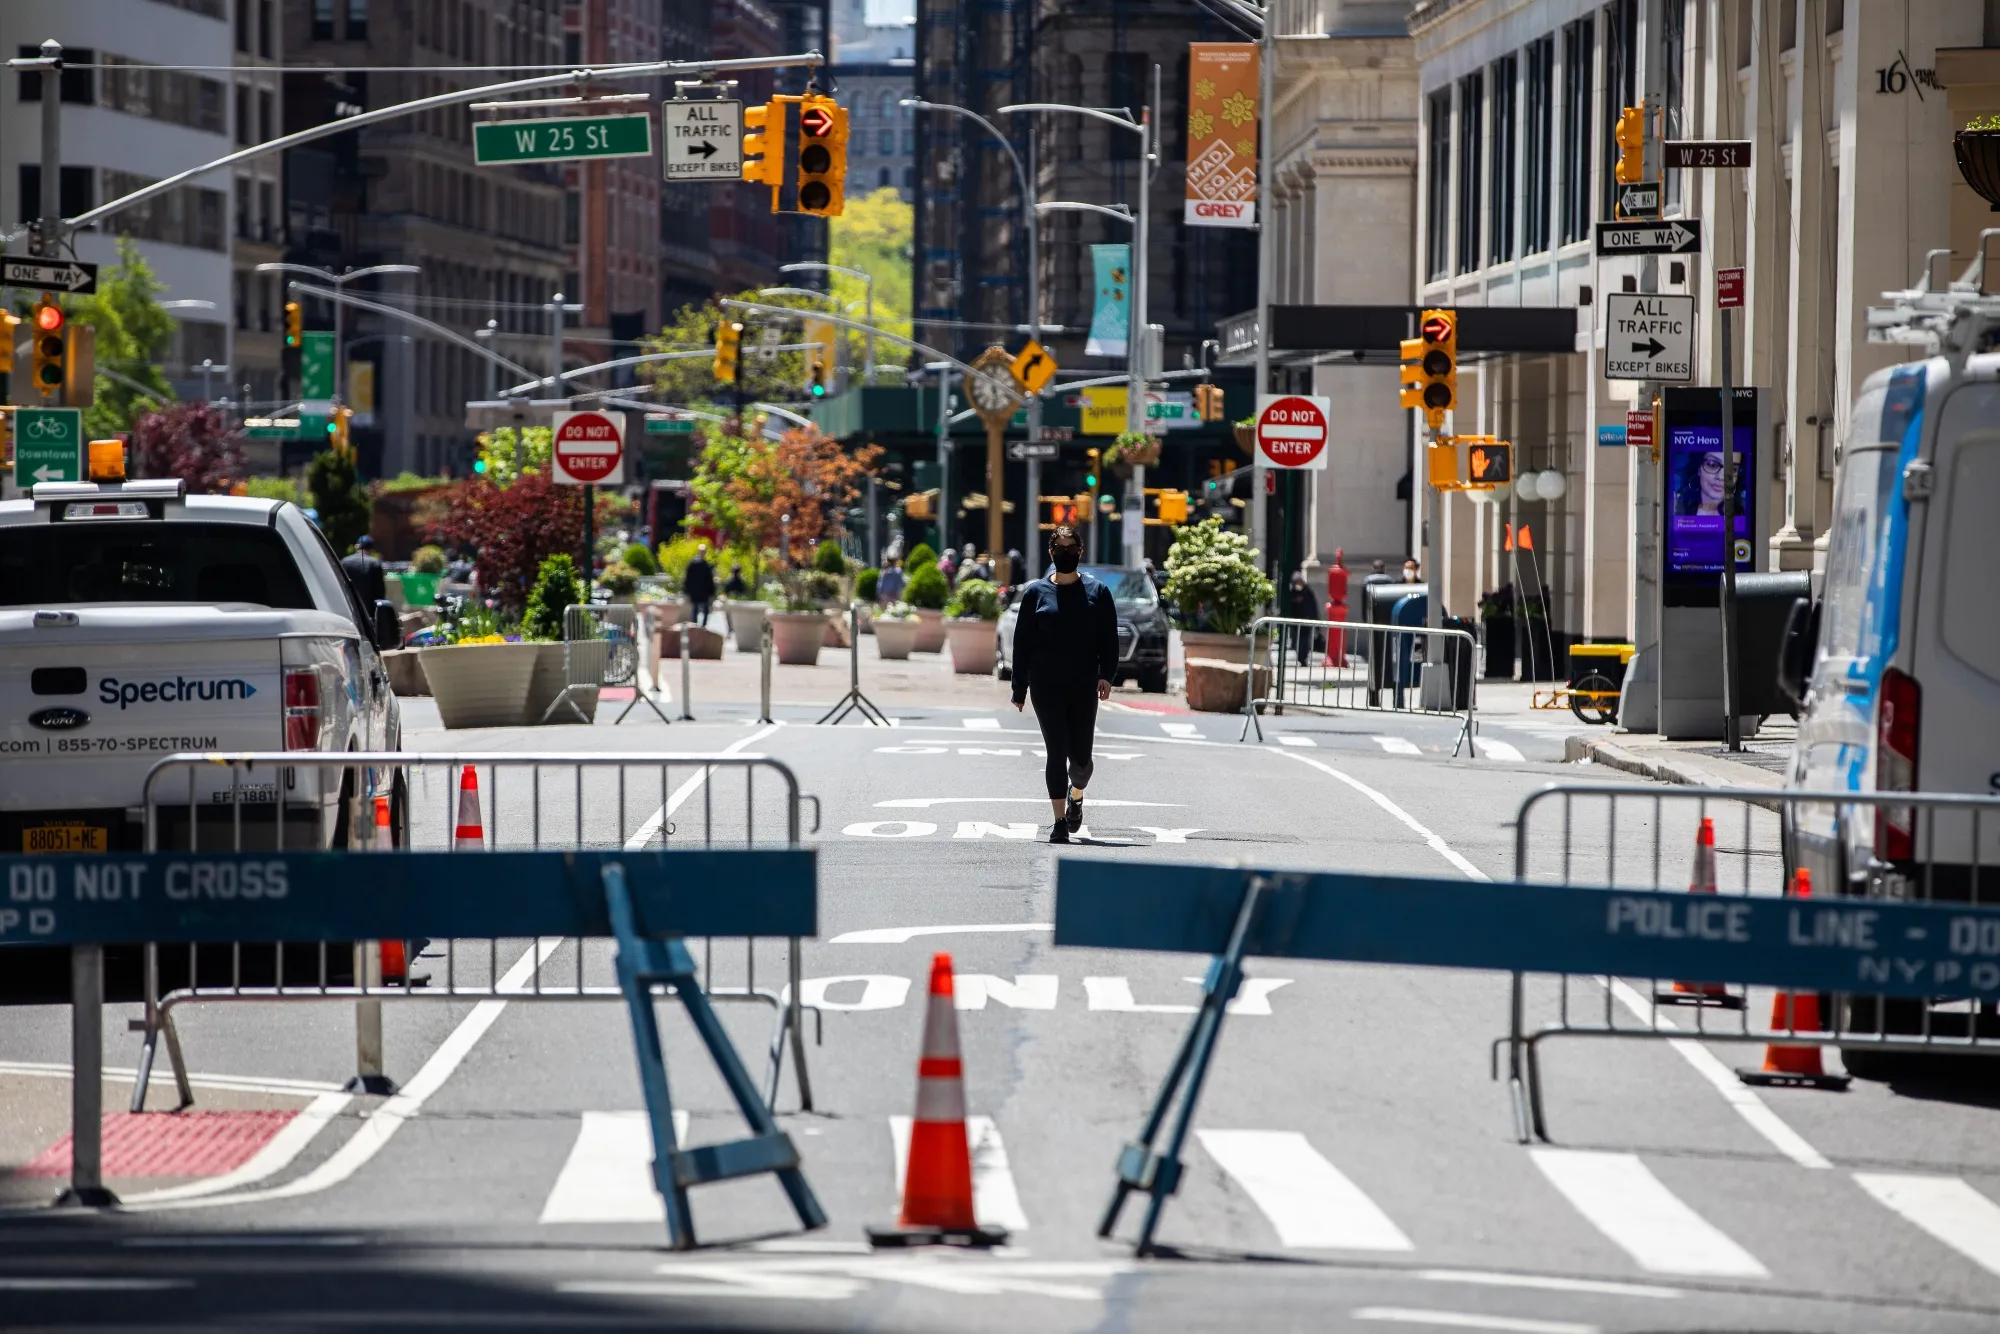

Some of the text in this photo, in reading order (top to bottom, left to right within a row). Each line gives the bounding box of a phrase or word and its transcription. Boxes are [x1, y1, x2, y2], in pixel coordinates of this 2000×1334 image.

[1876, 59, 1907, 94] 16
[687, 106, 718, 121] ALL
[515, 125, 609, 152] W 25 St
[674, 124, 732, 138] TRAFFIC
[1680, 149, 1737, 165] W 25 St
[669, 161, 739, 173] EXCEPT BIKES
[1188, 149, 1230, 184] MAD.
[1202, 173, 1232, 197] SQ.
[1624, 192, 1655, 207] ONE WAY
[1195, 203, 1245, 219] GREY
[1611, 229, 1685, 246] ONE WAY
[12, 265, 82, 283] ONE WAY
[1633, 299, 1668, 316] ALL
[1617, 319, 1683, 334] TRAFFIC
[1609, 361, 1688, 374] EXCEPT BIKES
[1270, 409, 1316, 422] DO NOT
[566, 426, 610, 437] DO NOT
[1271, 441, 1312, 454] ENTER
[1674, 436, 1719, 445] NYC Hero
[19, 449, 76, 459] Downtown
[568, 457, 608, 469] ENTER
[99, 676, 247, 710] Spectrum
[42, 711, 78, 726] Ford
[9, 861, 290, 900] DO NOT CROSS
[1607, 898, 1752, 943] POLICE
[1788, 908, 1880, 950] LINE
